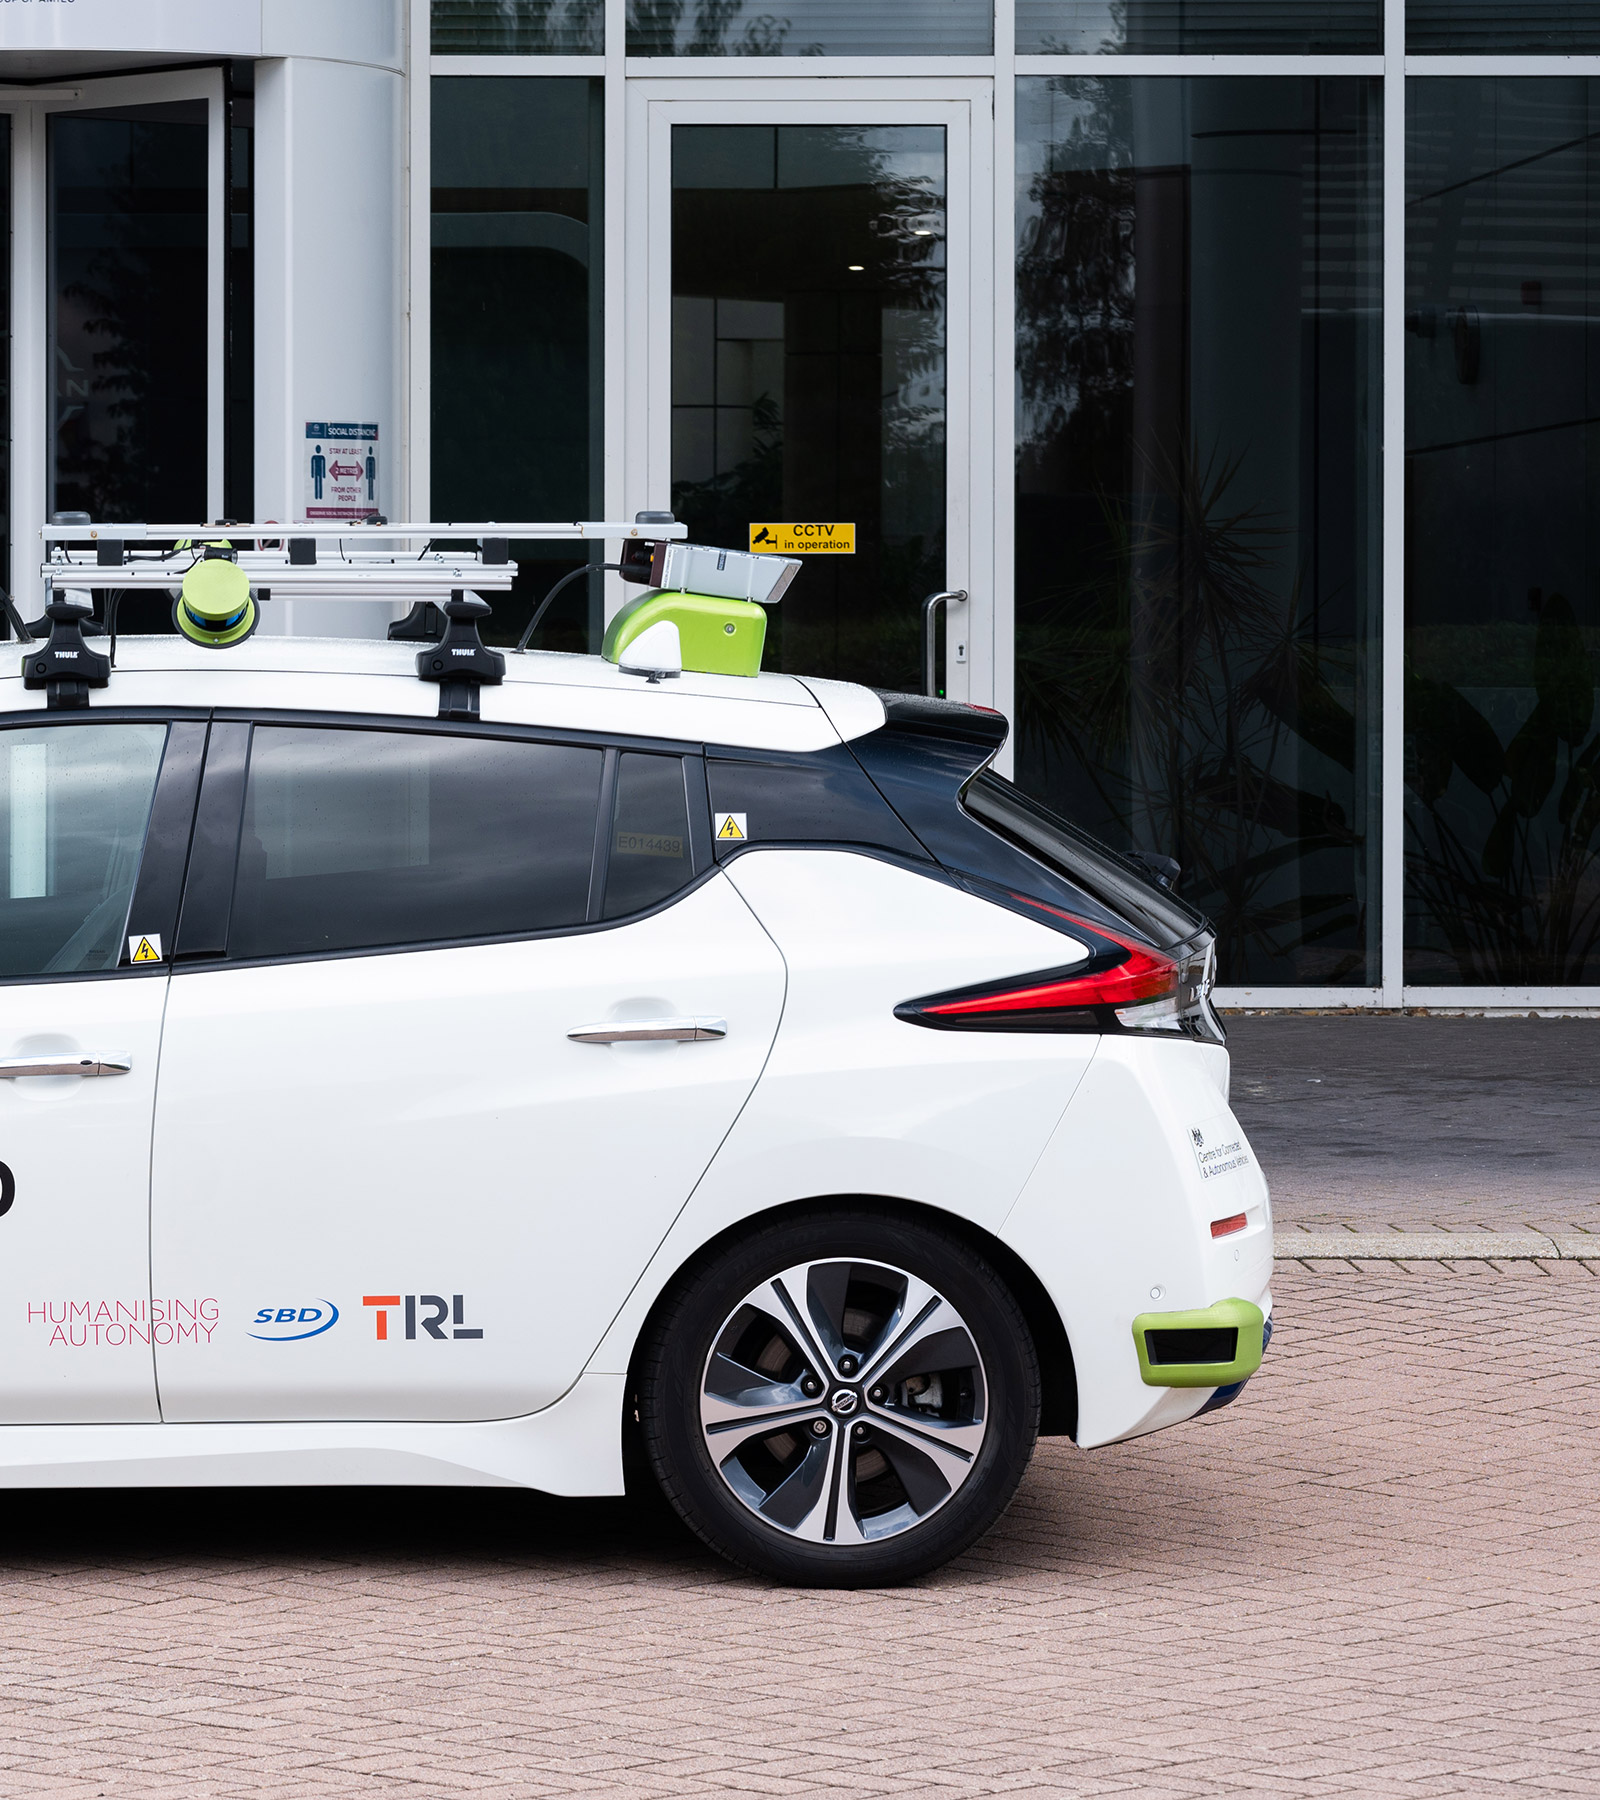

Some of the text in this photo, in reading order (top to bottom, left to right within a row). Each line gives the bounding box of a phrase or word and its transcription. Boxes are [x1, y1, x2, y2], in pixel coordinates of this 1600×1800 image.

[793, 525, 835, 536] CCTV
[784, 540, 850, 550] in operation
[54, 651, 79, 659] THULE
[451, 648, 476, 656] THULE
[618, 836, 680, 853] E014439
[1202, 1167, 1209, 1179] &
[27, 1297, 220, 1324] HUMANISING
[253, 1307, 323, 1324] SBD
[362, 1294, 484, 1340] TRL
[48, 1322, 219, 1347] AUTONOMY
